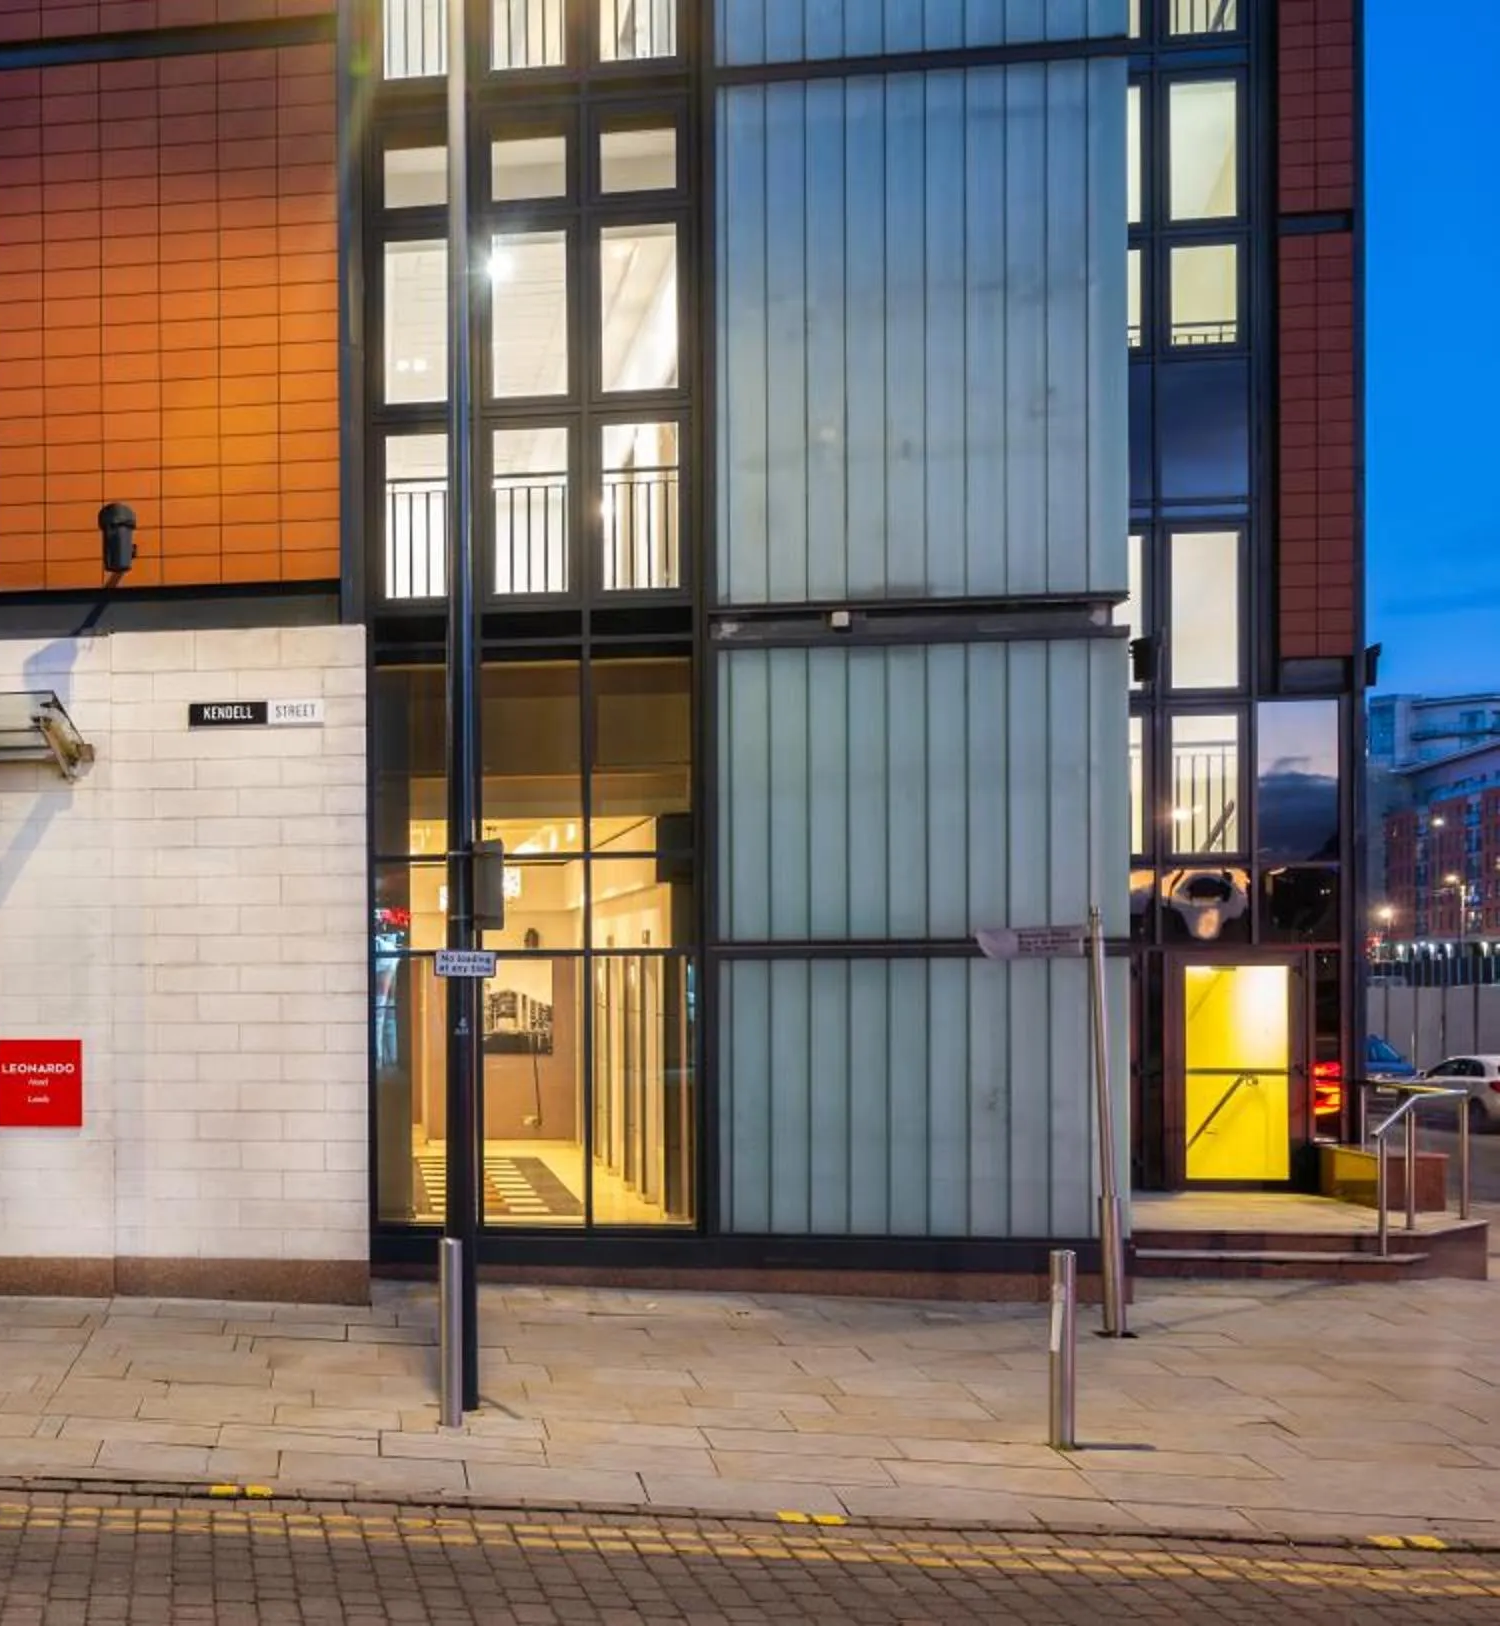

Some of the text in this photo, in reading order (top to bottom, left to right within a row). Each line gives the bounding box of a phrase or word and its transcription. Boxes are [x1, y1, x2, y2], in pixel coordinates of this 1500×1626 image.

[203, 703, 316, 720] KENDELL STREET
[441, 953, 491, 964] No loading
[439, 964, 449, 972] at
[451, 965, 468, 973] any
[1, 1063, 75, 1074] LEONARDO
